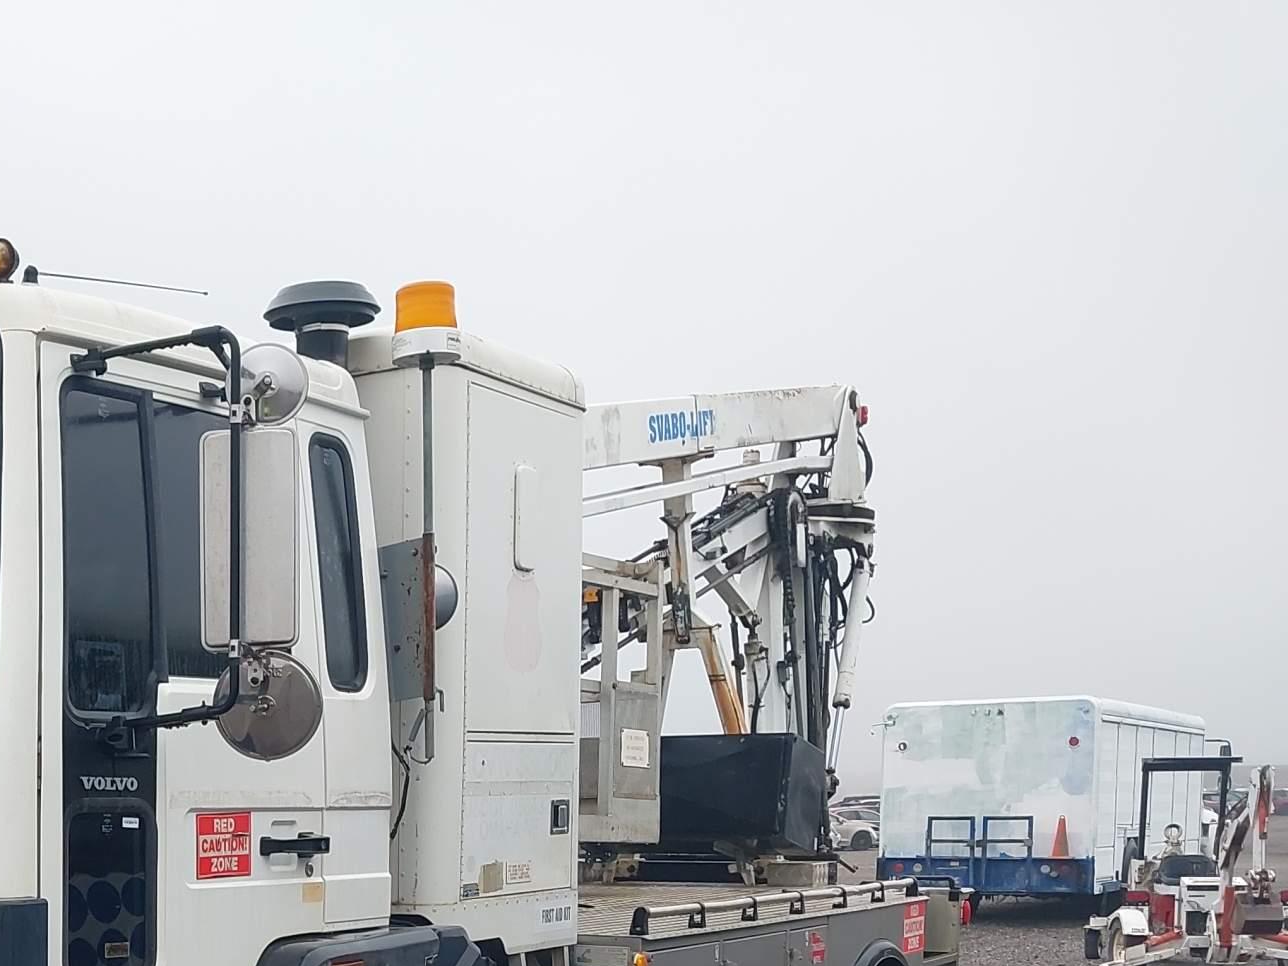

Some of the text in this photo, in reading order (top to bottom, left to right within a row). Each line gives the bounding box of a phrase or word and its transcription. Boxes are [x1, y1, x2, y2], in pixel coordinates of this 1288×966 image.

[648, 409, 716, 444] SVABO-LIFT
[79, 775, 139, 792] VOLVO
[213, 817, 235, 833] RED
[201, 835, 248, 854] CAUTION!
[210, 856, 239, 873] ZONE
[563, 906, 571, 921] KIT
